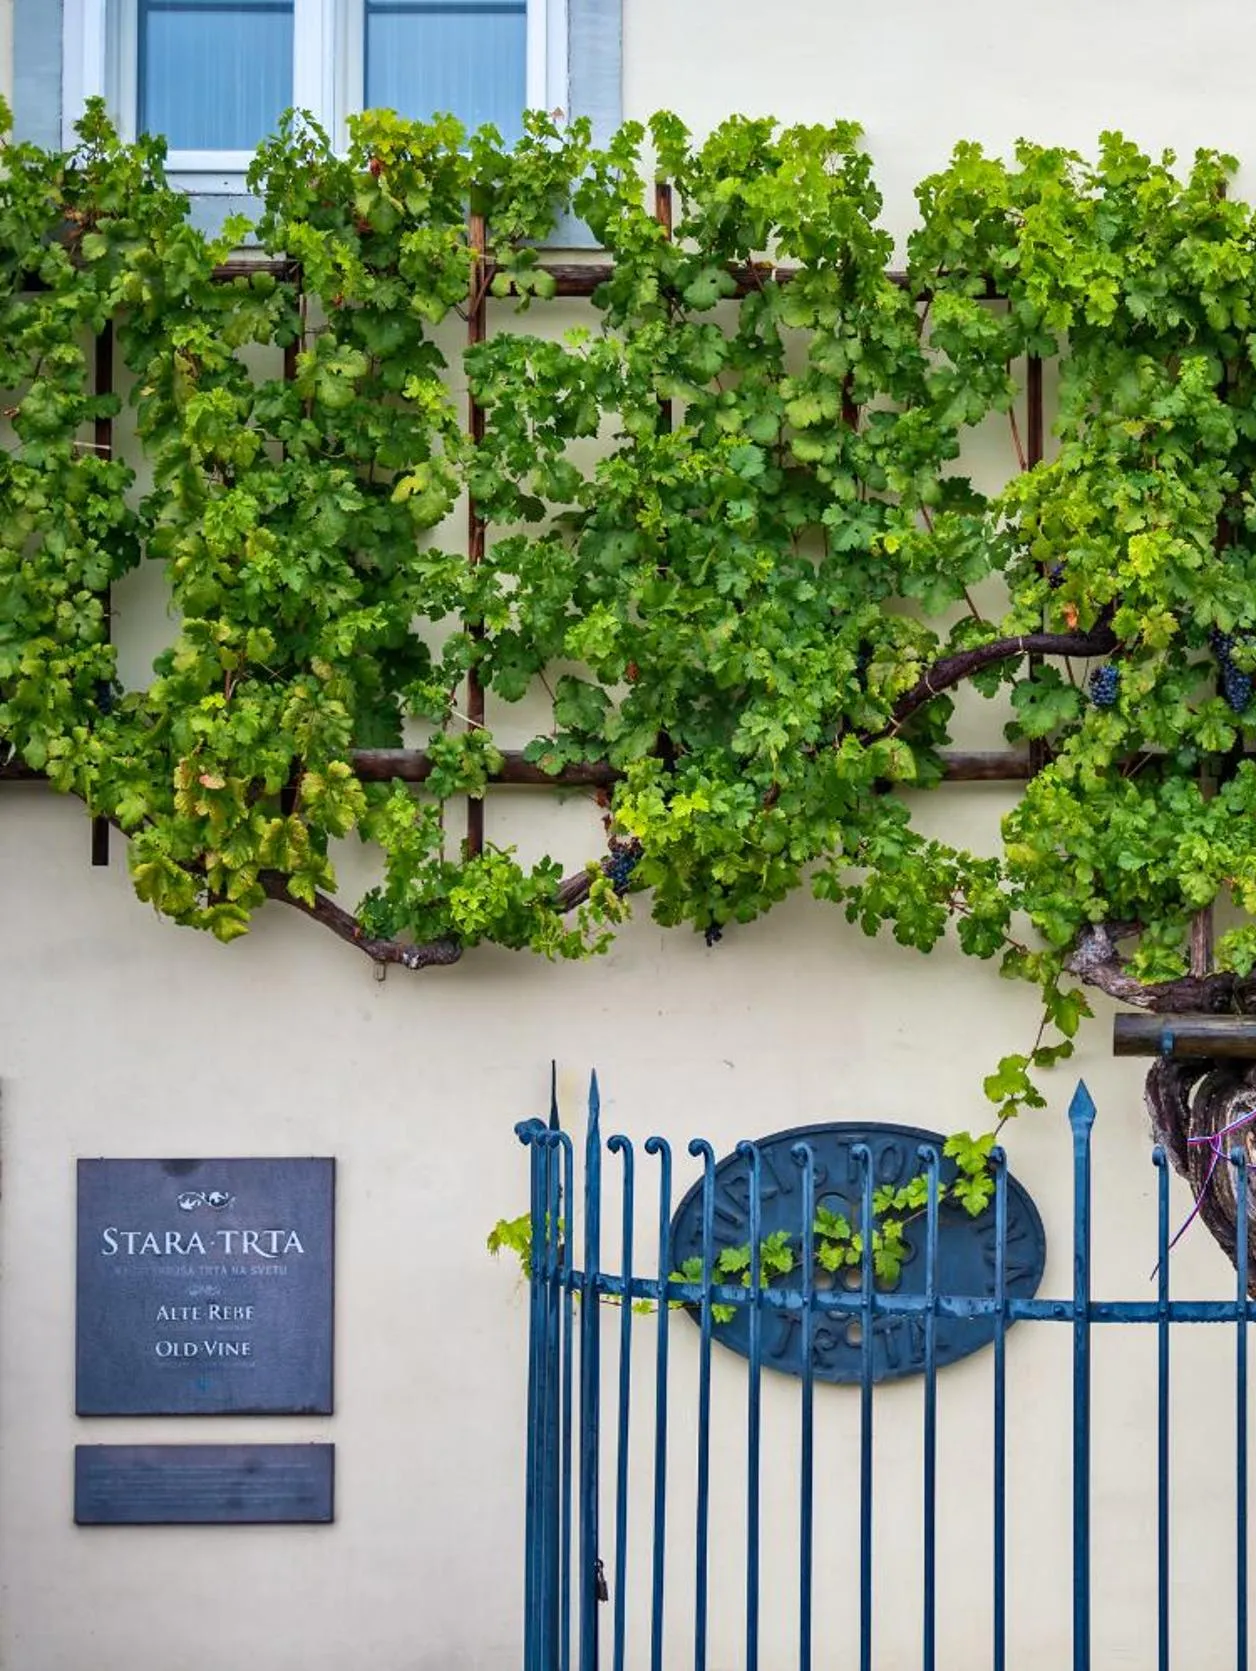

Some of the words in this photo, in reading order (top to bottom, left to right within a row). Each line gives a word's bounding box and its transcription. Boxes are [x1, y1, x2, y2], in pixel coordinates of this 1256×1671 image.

[102, 1227, 206, 1255] STARA
[216, 1230, 304, 1258] TRTA
[157, 1305, 200, 1320] ALTE
[156, 1340, 198, 1357] OLD
[204, 1340, 252, 1356] VINE
